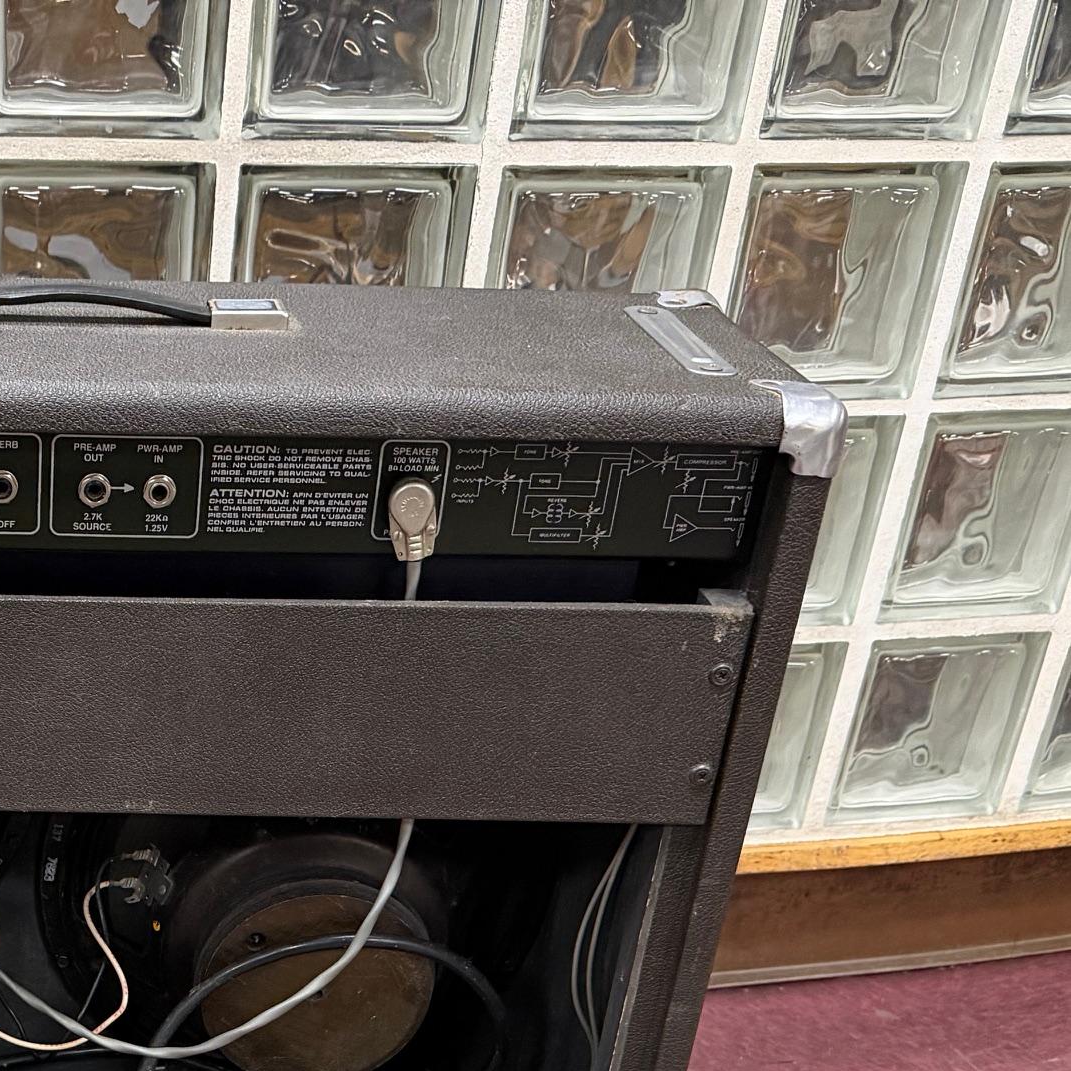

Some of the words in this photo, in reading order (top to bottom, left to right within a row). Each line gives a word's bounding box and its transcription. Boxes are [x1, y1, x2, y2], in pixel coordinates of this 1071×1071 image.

[73, 443, 117, 453] PRE-AMP
[136, 444, 184, 454] PWR-AMP
[213, 444, 281, 454] CAUTION:
[393, 447, 439, 456] SPEAKER
[84, 453, 104, 463] OUT
[153, 454, 164, 464] IN
[209, 488, 290, 498] ATTENTION:
[83, 513, 103, 521] 2.7K
[73, 522, 112, 532] SOURCE
[144, 524, 168, 532] 1.25V
